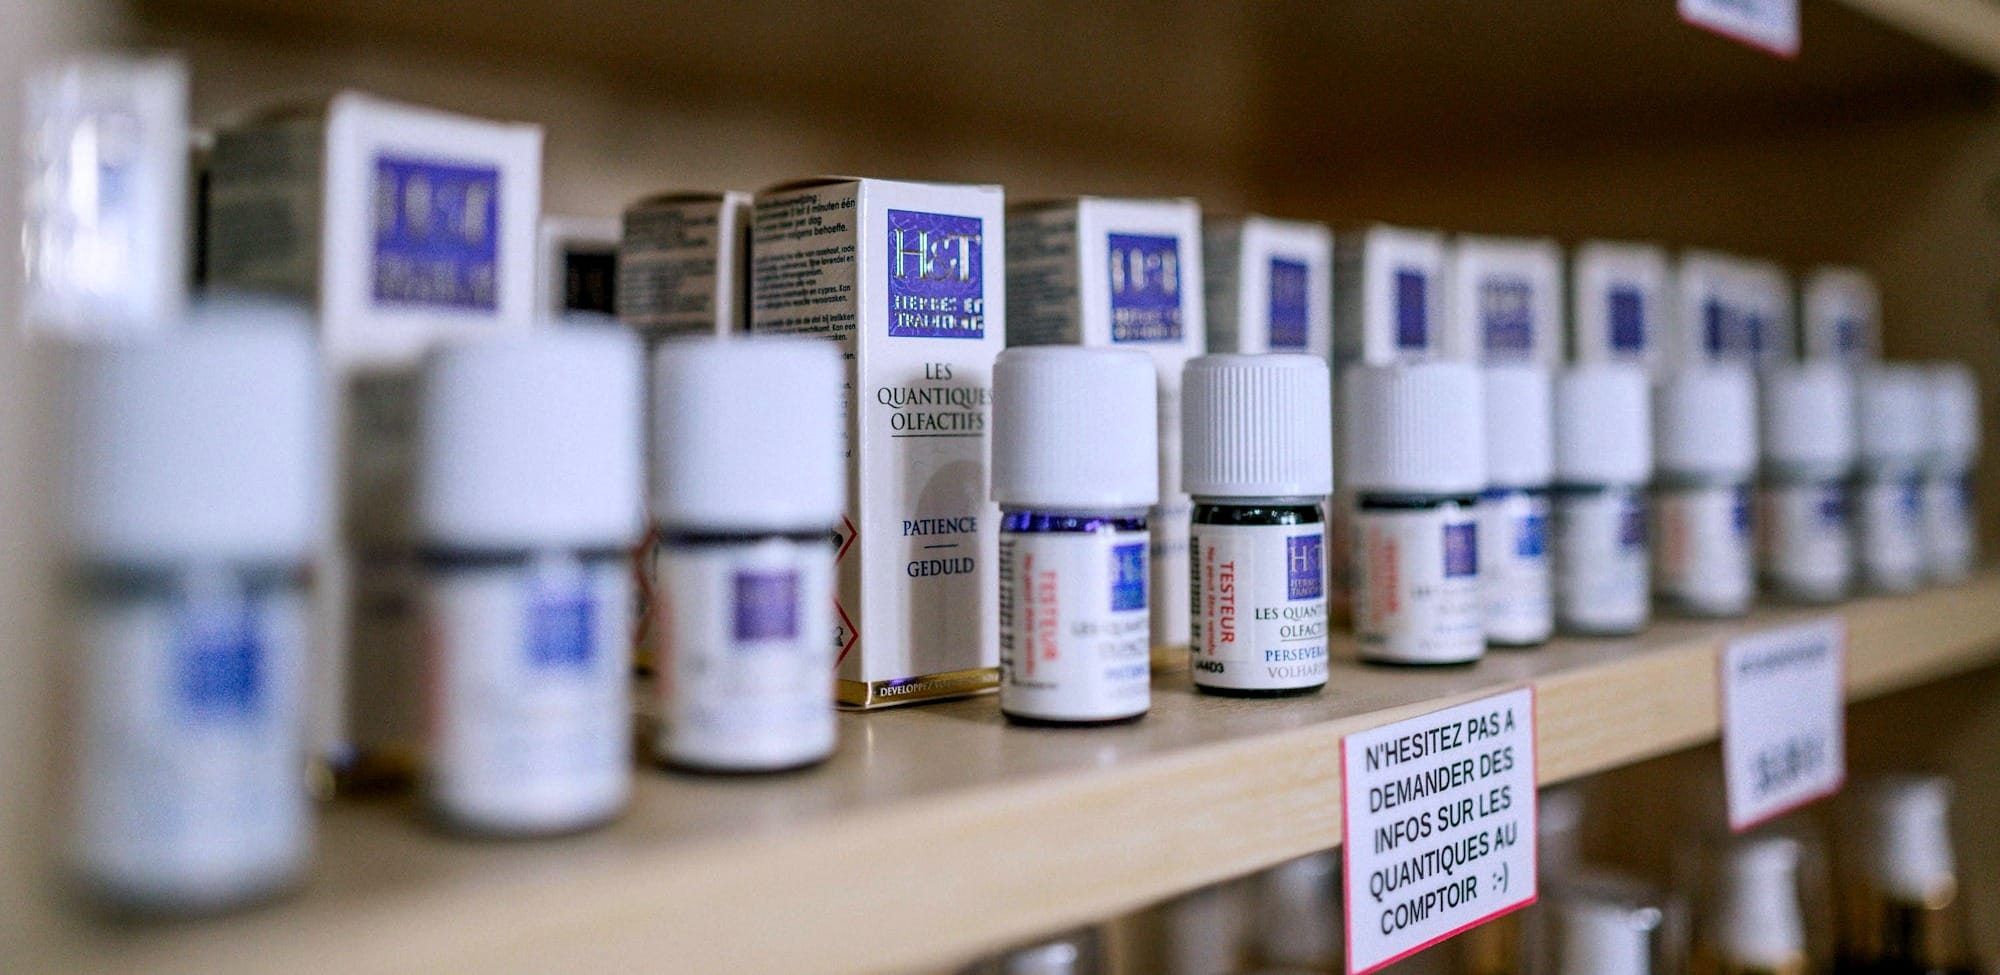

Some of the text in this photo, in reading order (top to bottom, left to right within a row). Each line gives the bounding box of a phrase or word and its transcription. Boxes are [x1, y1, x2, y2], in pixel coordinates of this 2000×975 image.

[891, 228, 982, 283] H&T
[926, 363, 953, 381] LES
[890, 412, 985, 431] OLFACTIFS
[903, 516, 977, 537] PATIENCE
[907, 557, 975, 578] GEDULD
[1219, 560, 1236, 644] TESTEUR
[1255, 607, 1279, 620] LES
[1365, 707, 1517, 773] N'HESITEZ PAS A
[1369, 745, 1514, 814] DEMANDER DES
[1374, 784, 1512, 855] INFOS SUR LES
[1369, 820, 1518, 903] QUANTIQUES AU
[1380, 874, 1478, 936] COMPTOIR
